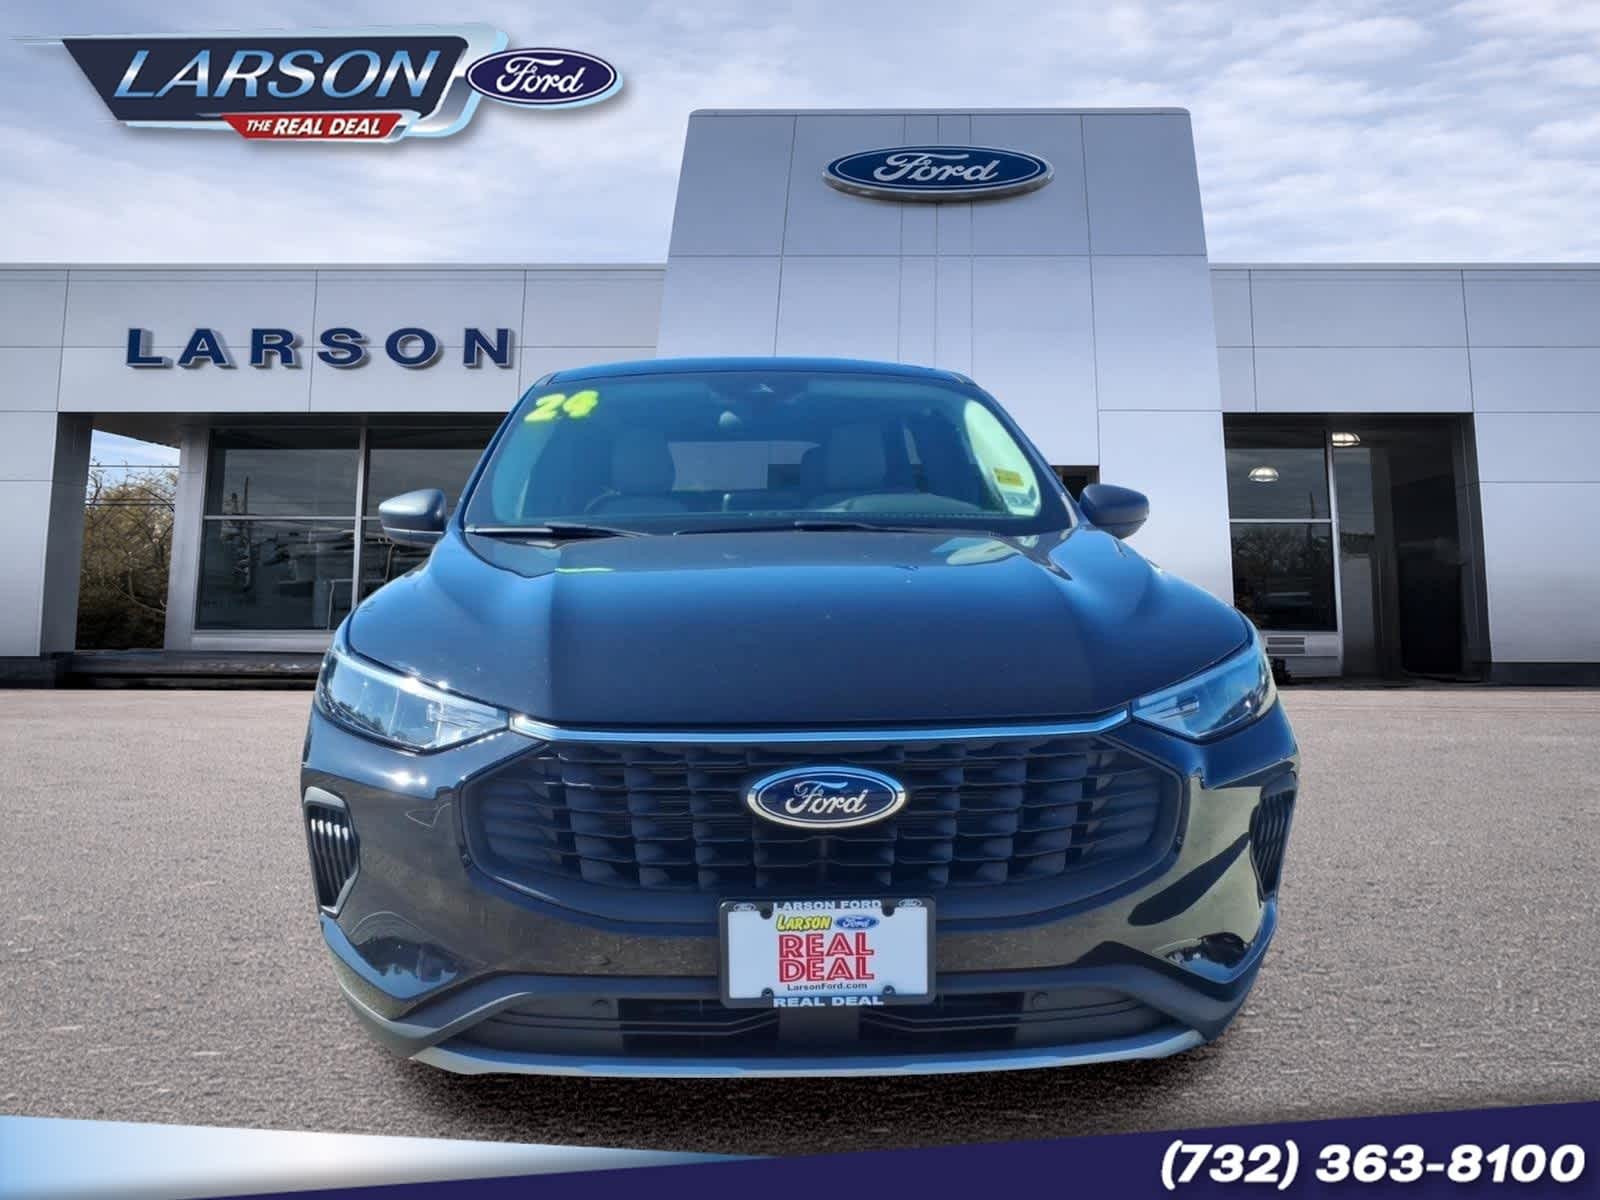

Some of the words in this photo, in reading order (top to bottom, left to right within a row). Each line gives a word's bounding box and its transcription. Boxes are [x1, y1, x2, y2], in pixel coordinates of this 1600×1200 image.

[873, 152, 1000, 181] Ford
[126, 328, 516, 369] LARSON
[785, 780, 868, 814] Ford
[773, 901, 835, 912] LARSON
[840, 900, 882, 910] FORD
[841, 916, 871, 929] Ford
[779, 932, 874, 957] REAL
[779, 957, 874, 982] DEAL
[787, 982, 868, 992] LarsonFord.com
[773, 996, 825, 1008] REAL
[831, 996, 885, 1007] DEAL
